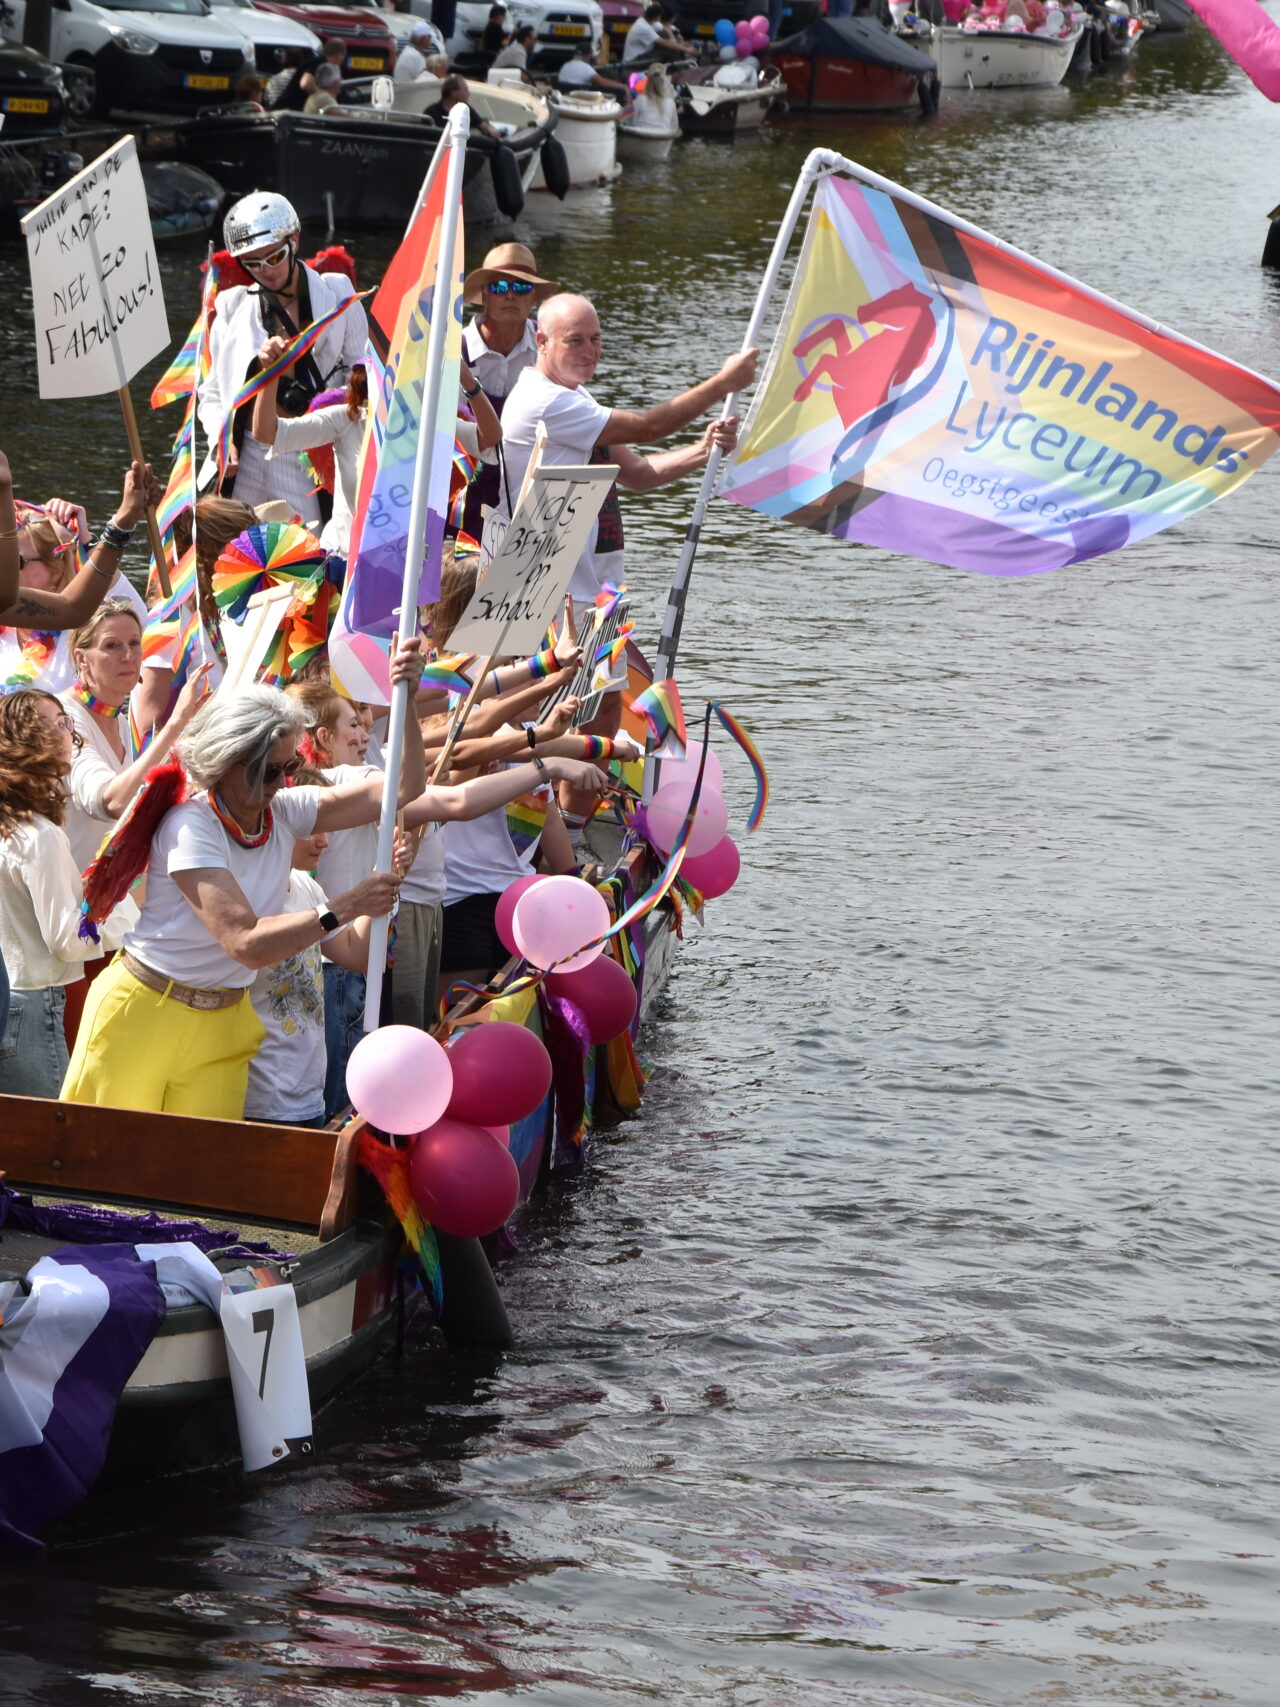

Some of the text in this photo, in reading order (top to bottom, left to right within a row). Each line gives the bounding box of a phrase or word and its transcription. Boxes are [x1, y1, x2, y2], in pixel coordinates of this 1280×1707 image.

[105, 152, 122, 182] DE
[57, 189, 111, 255] KADE?
[945, 380, 1163, 499] Lyceum
[970, 316, 1249, 474] Rijnlands
[252, 1308, 274, 1401] 7
